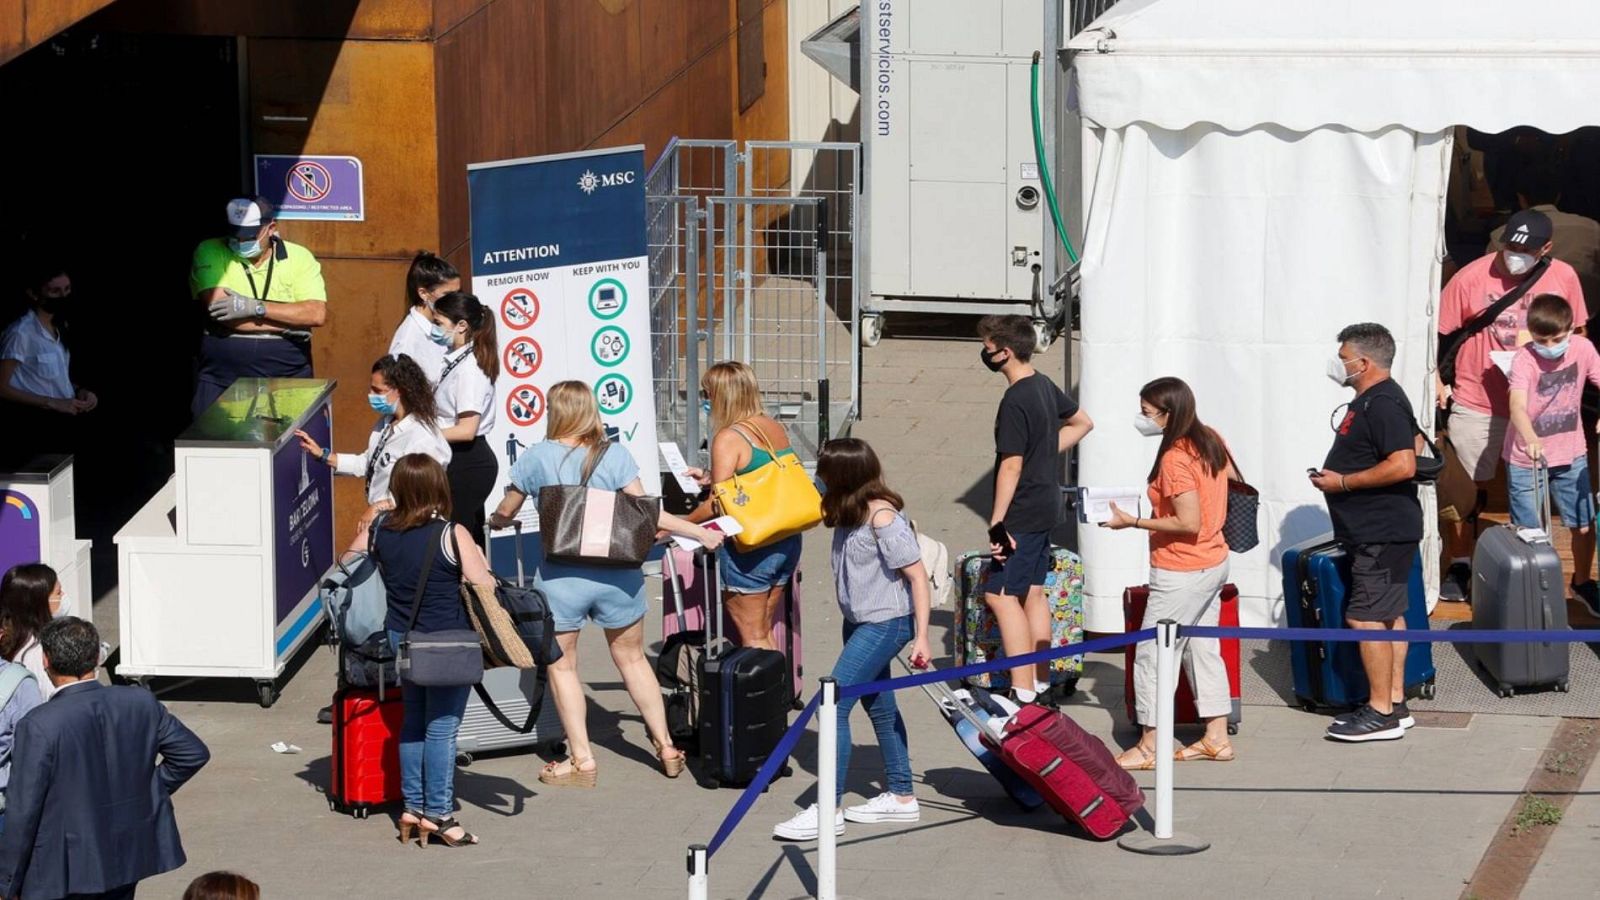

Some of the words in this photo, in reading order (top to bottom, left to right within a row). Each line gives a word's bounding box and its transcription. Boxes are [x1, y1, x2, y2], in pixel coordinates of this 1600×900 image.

[878, 0, 894, 136] stservicios.com
[601, 171, 635, 187] MSC
[483, 244, 560, 265] ATTENTION
[573, 266, 594, 277] KEEP
[596, 264, 620, 275] WITH
[622, 261, 641, 271] YOU
[487, 275, 524, 287] REMOVE
[526, 272, 550, 282] NOW
